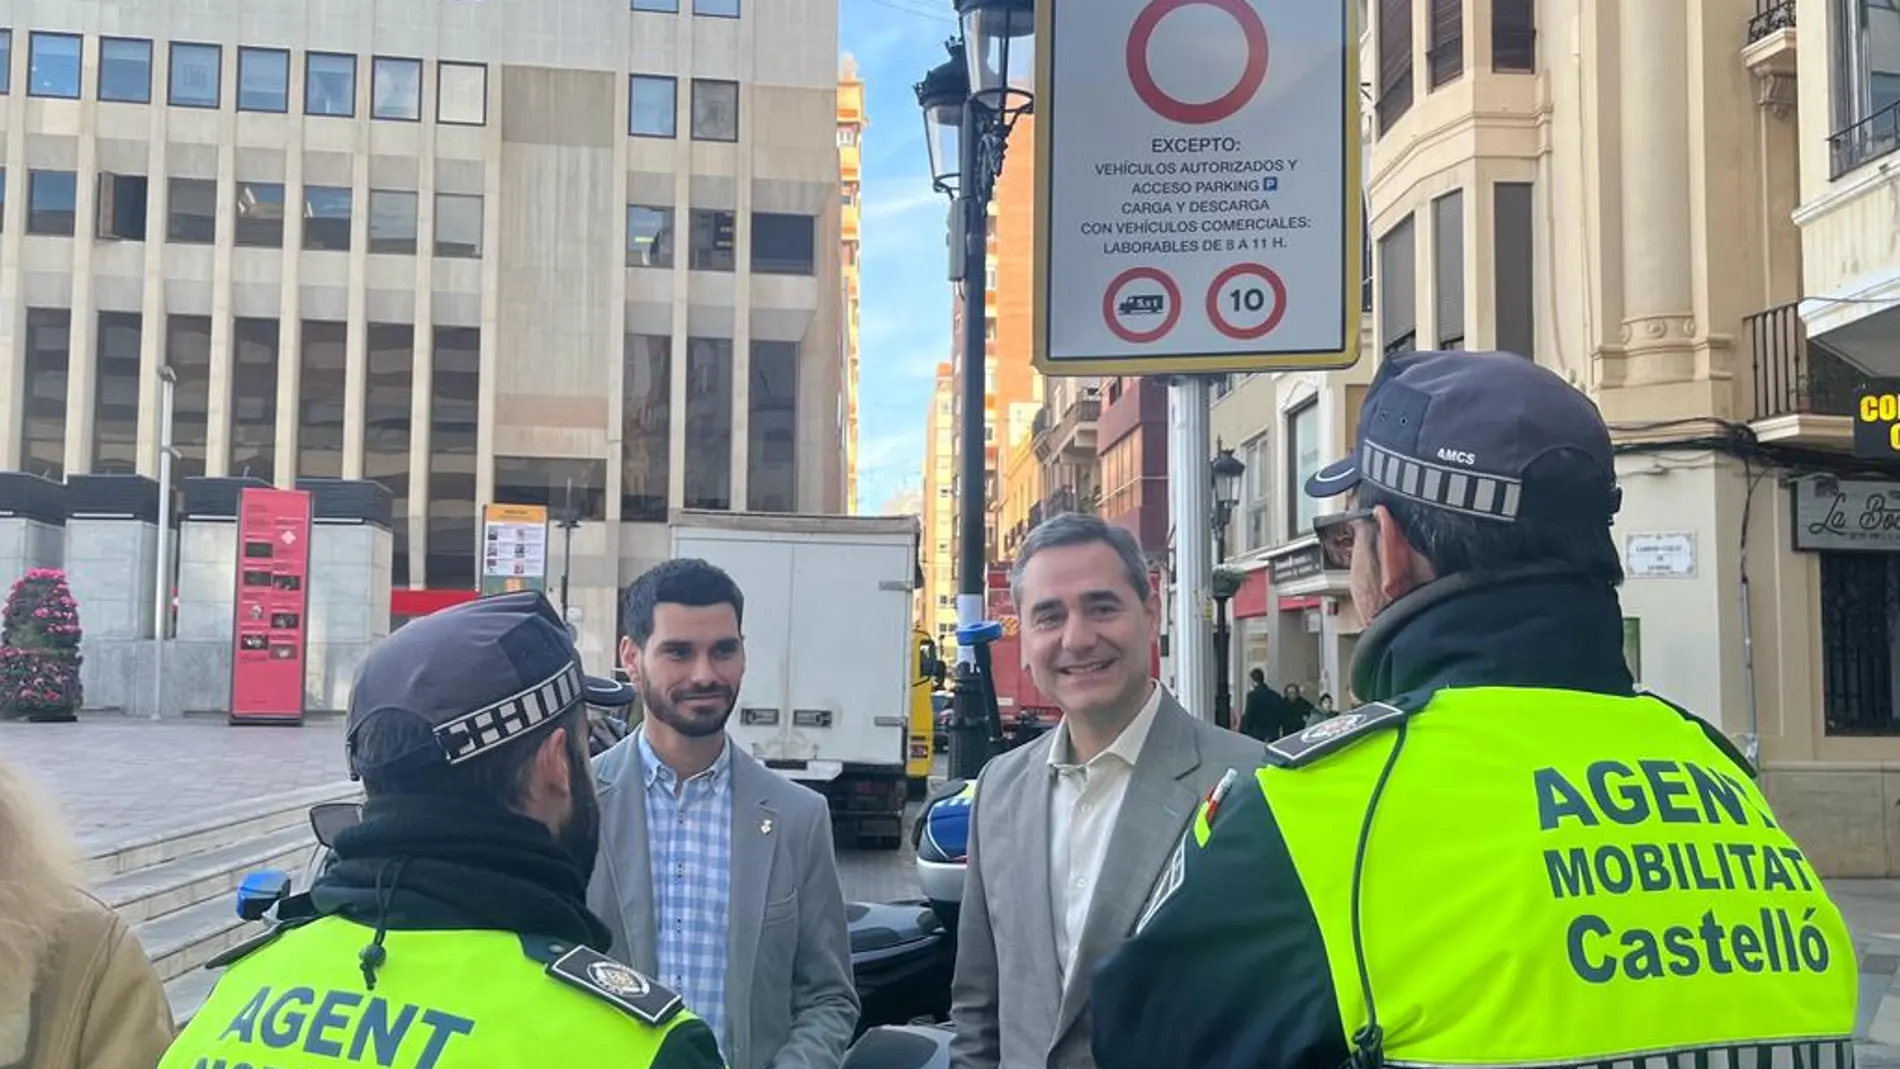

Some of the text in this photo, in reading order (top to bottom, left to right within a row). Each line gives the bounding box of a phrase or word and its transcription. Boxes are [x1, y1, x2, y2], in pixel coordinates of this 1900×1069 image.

[1151, 137, 1240, 153] EXCEPTO:
[1095, 160, 1298, 175] VEHÍCULOS AUTORIZADOS Y
[1132, 181, 1192, 194] ACCESO
[1196, 180, 1259, 193] PARKING
[1121, 199, 1270, 214] CARGA Y DESCARGA
[1081, 217, 1312, 235] CON VEHÍCULOS COMERCIALES:
[1103, 237, 1288, 254] LABORABLES DE 8 A 11 H.
[1230, 288, 1265, 312] 10
[1860, 394, 1900, 422] CO
[1437, 447, 1476, 466] AMCS
[1808, 492, 1847, 536] La
[1543, 842, 1813, 899] MOBILITAT
[1566, 907, 1829, 984] Castelló
[217, 985, 476, 1069] AGENT
